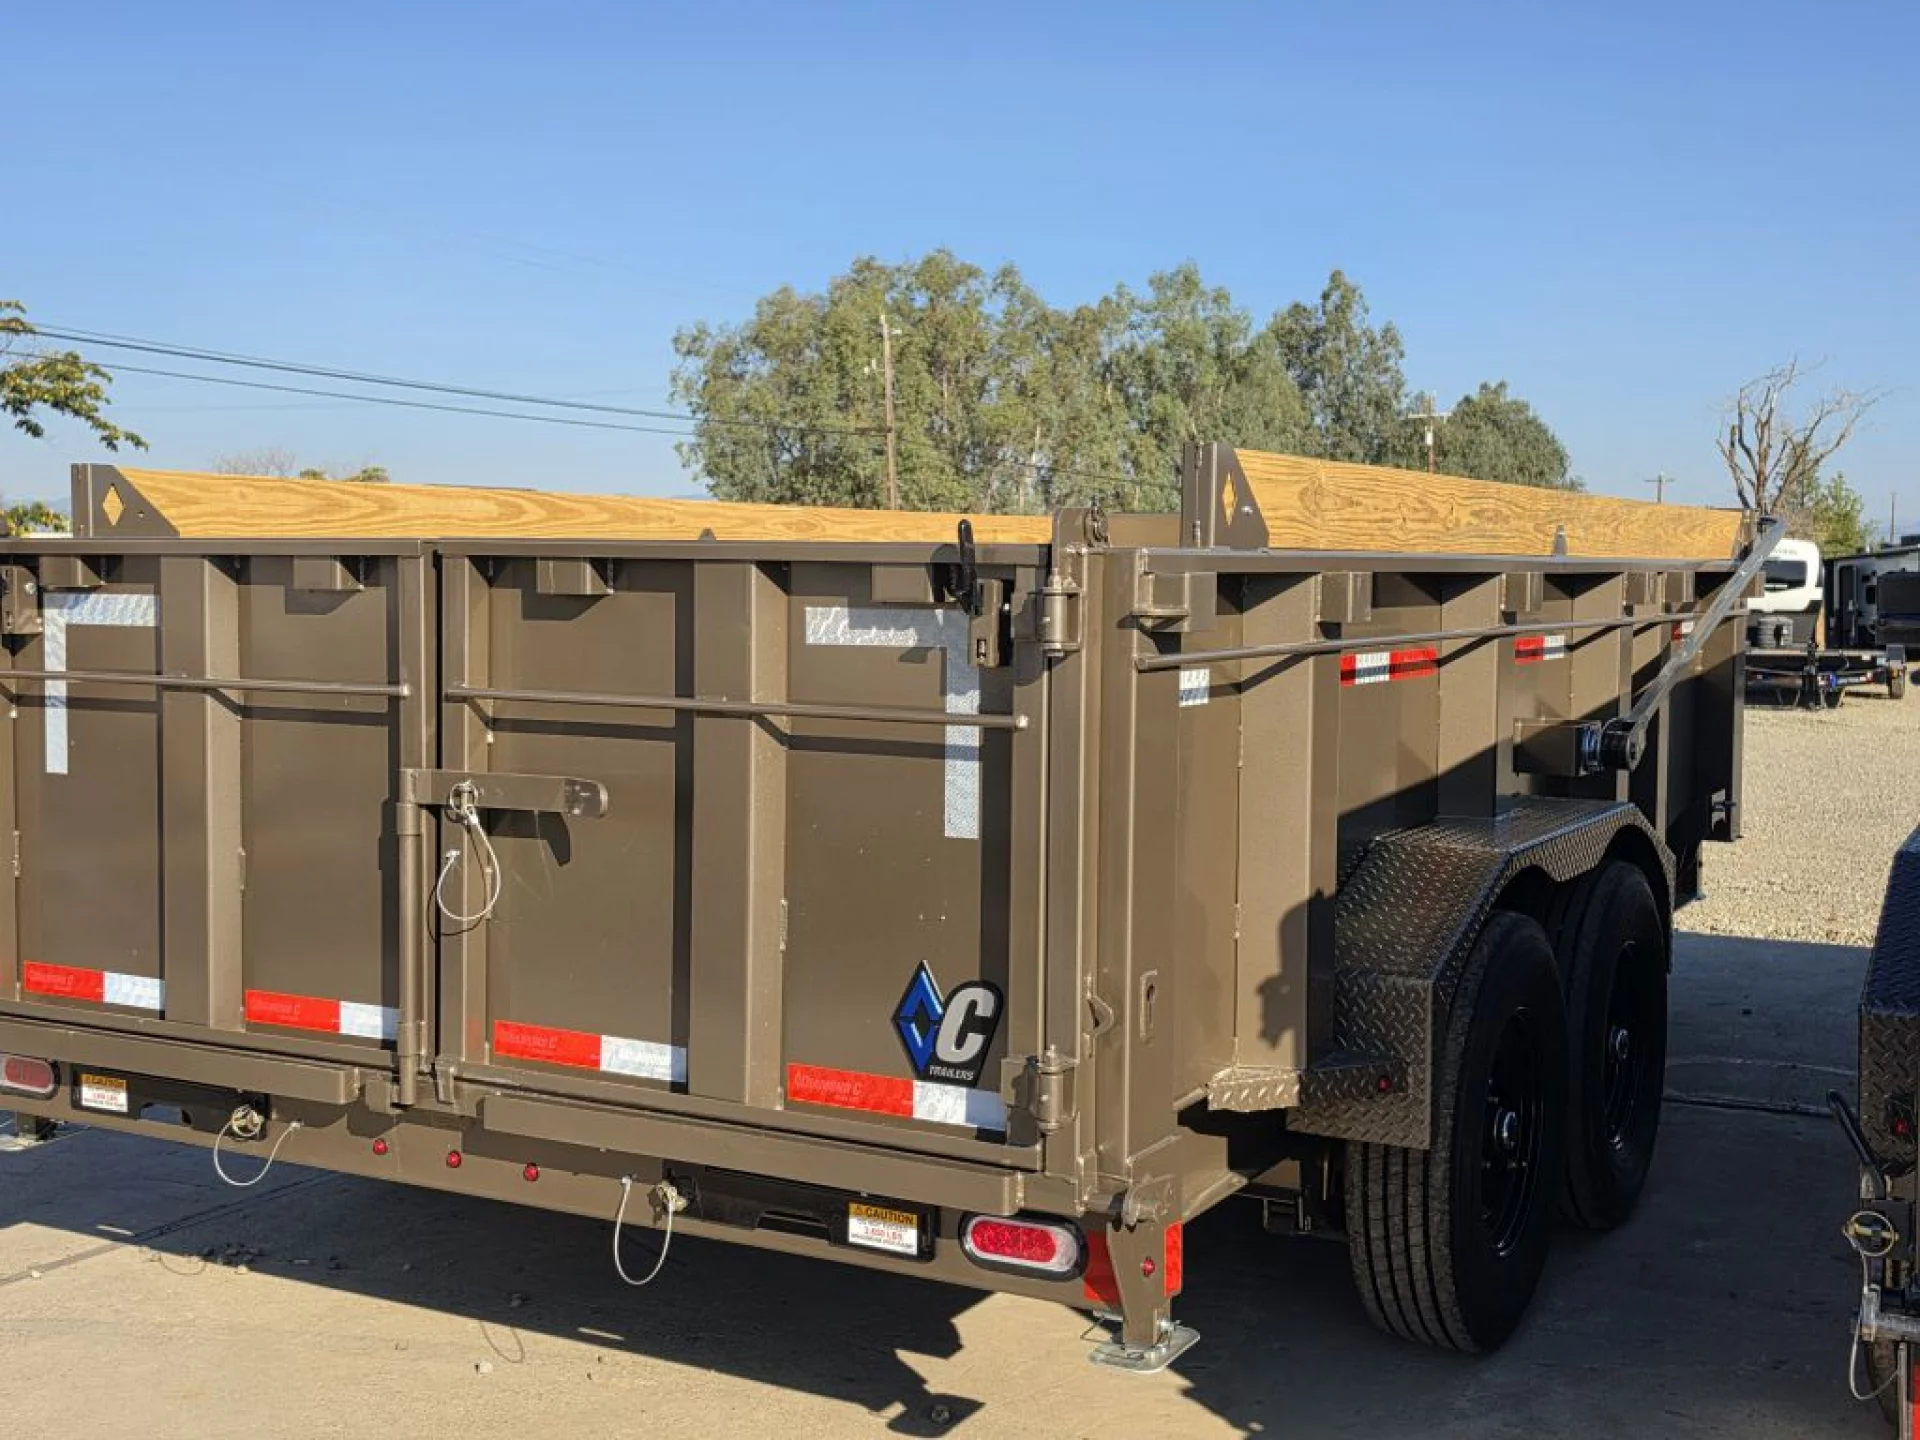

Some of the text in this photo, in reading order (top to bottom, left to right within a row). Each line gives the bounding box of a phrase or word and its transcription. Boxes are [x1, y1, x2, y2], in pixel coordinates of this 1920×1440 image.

[935, 987, 995, 1063] C
[929, 1065, 974, 1080] TRAILERS
[867, 1206, 914, 1225] CAUTION
